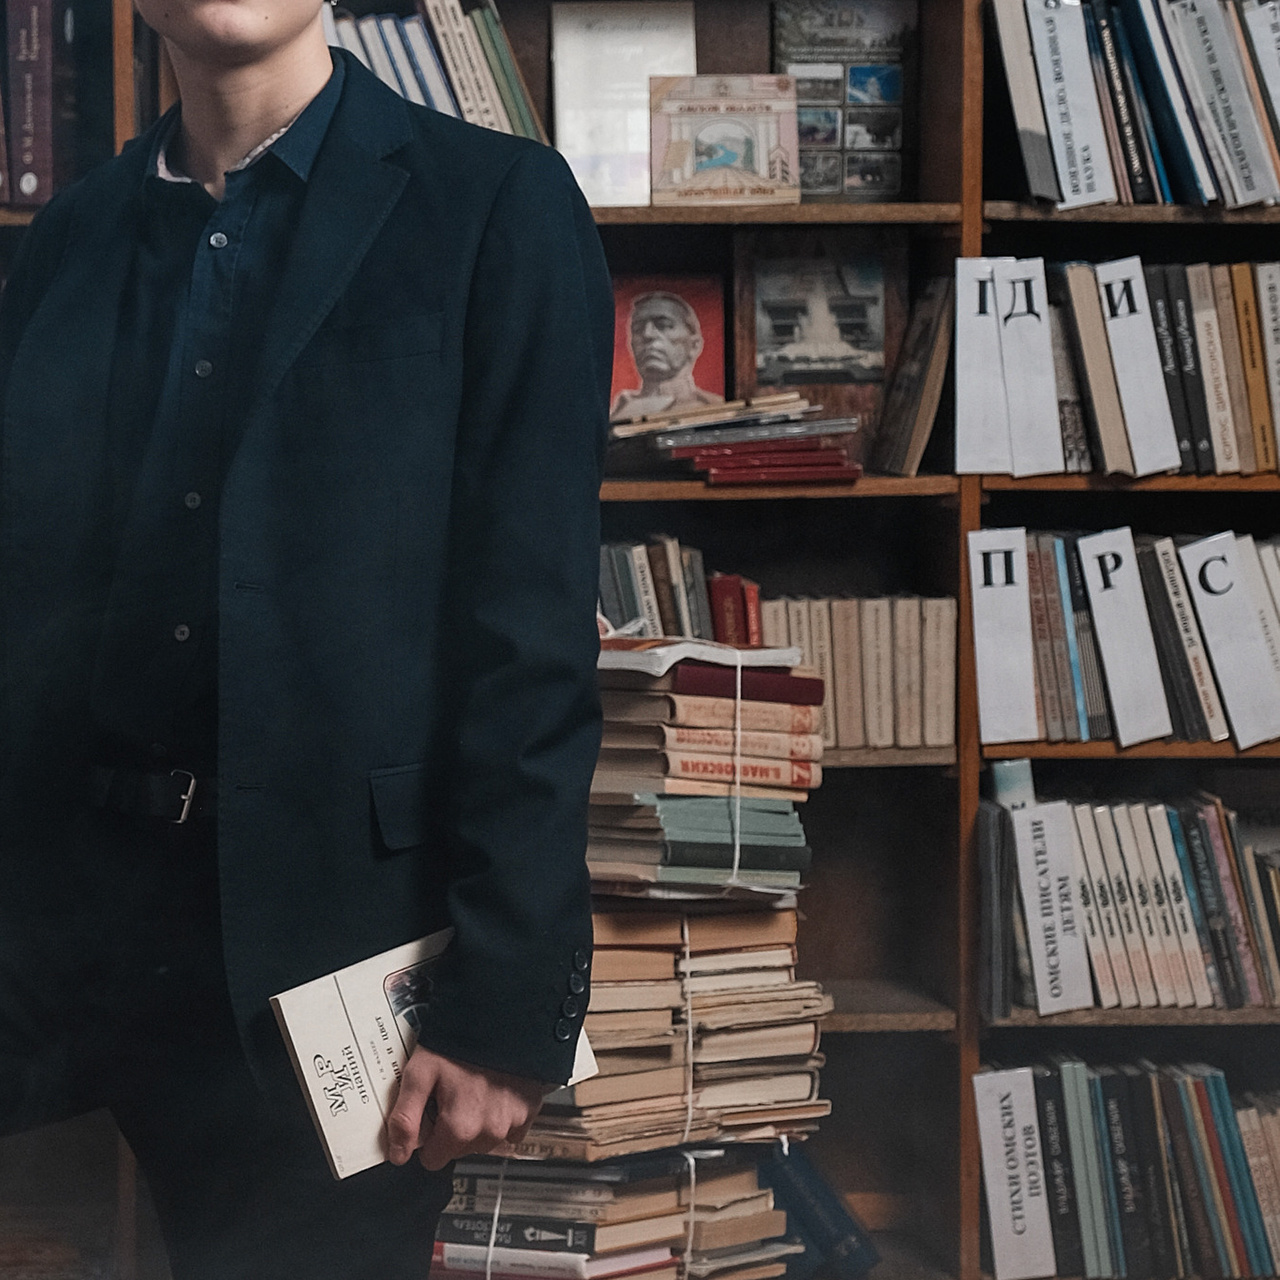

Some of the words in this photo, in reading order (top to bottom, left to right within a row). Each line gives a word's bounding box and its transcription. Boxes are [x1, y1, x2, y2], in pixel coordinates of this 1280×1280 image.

[1060, 128, 1080, 196] ВОЕННОЕ
[1082, 144, 1097, 193] НАУКА
[1003, 278, 1041, 324] Д
[1104, 279, 1141, 320] И
[979, 550, 1016, 588] П
[1094, 551, 1123, 592] Р
[1198, 554, 1236, 596] С
[679, 760, 782, 781] В.МАЯОВСКИЙ
[1031, 819, 1054, 919] ПИСАТЕЛИ
[1056, 874, 1078, 940] ДЕТЯМ
[1040, 924, 1063, 998] ОМСКИЕ
[313, 1053, 354, 1117] МИР
[341, 1045, 370, 1105] знаний
[998, 1091, 1022, 1168] ОМСКИХ
[1022, 1123, 1045, 1198] ПОЭТОВ
[451, 1218, 513, 1234] АРСТОТЕЛЬ
[1007, 1169, 1028, 1237] СТИХИ
[472, 1229, 512, 1244] ПЛАОН
